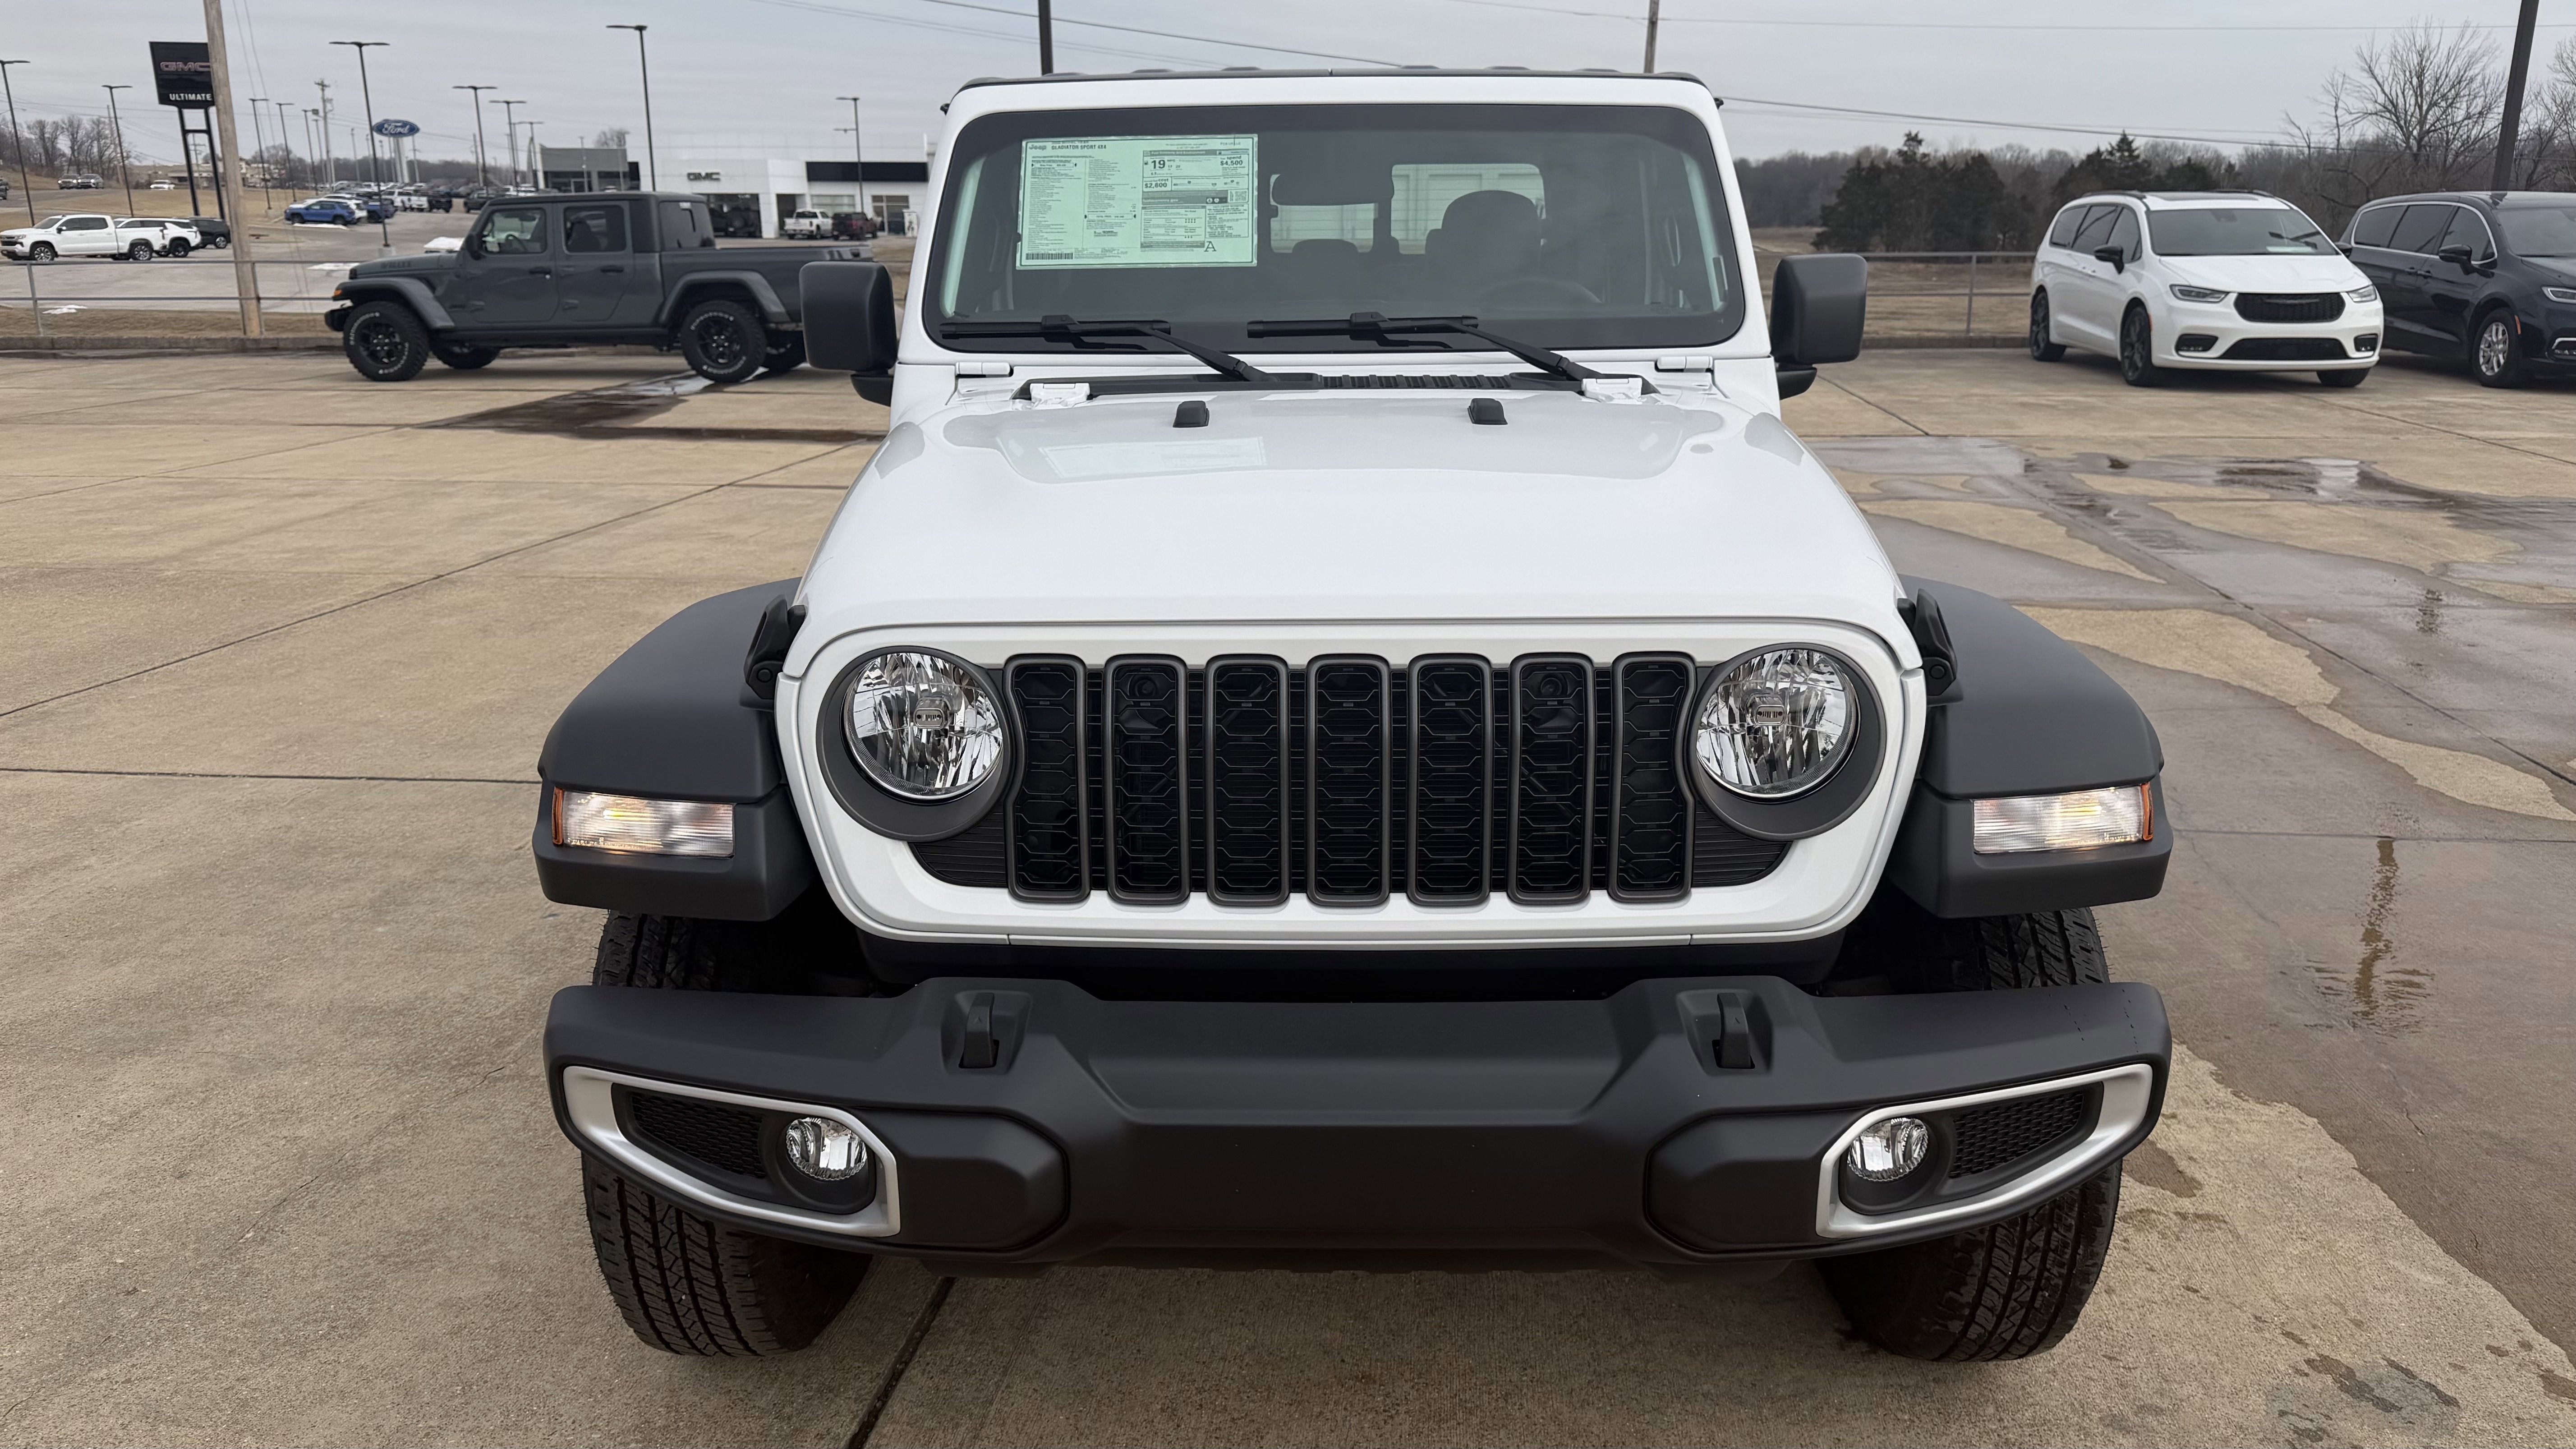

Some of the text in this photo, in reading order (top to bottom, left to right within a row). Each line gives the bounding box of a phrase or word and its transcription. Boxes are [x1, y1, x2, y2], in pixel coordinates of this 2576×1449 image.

[160, 62, 211, 71] GMC
[382, 122, 409, 134] Ford
[1151, 160, 1166, 169] 19
[687, 172, 721, 181] GMC
[1204, 241, 1217, 252] A
